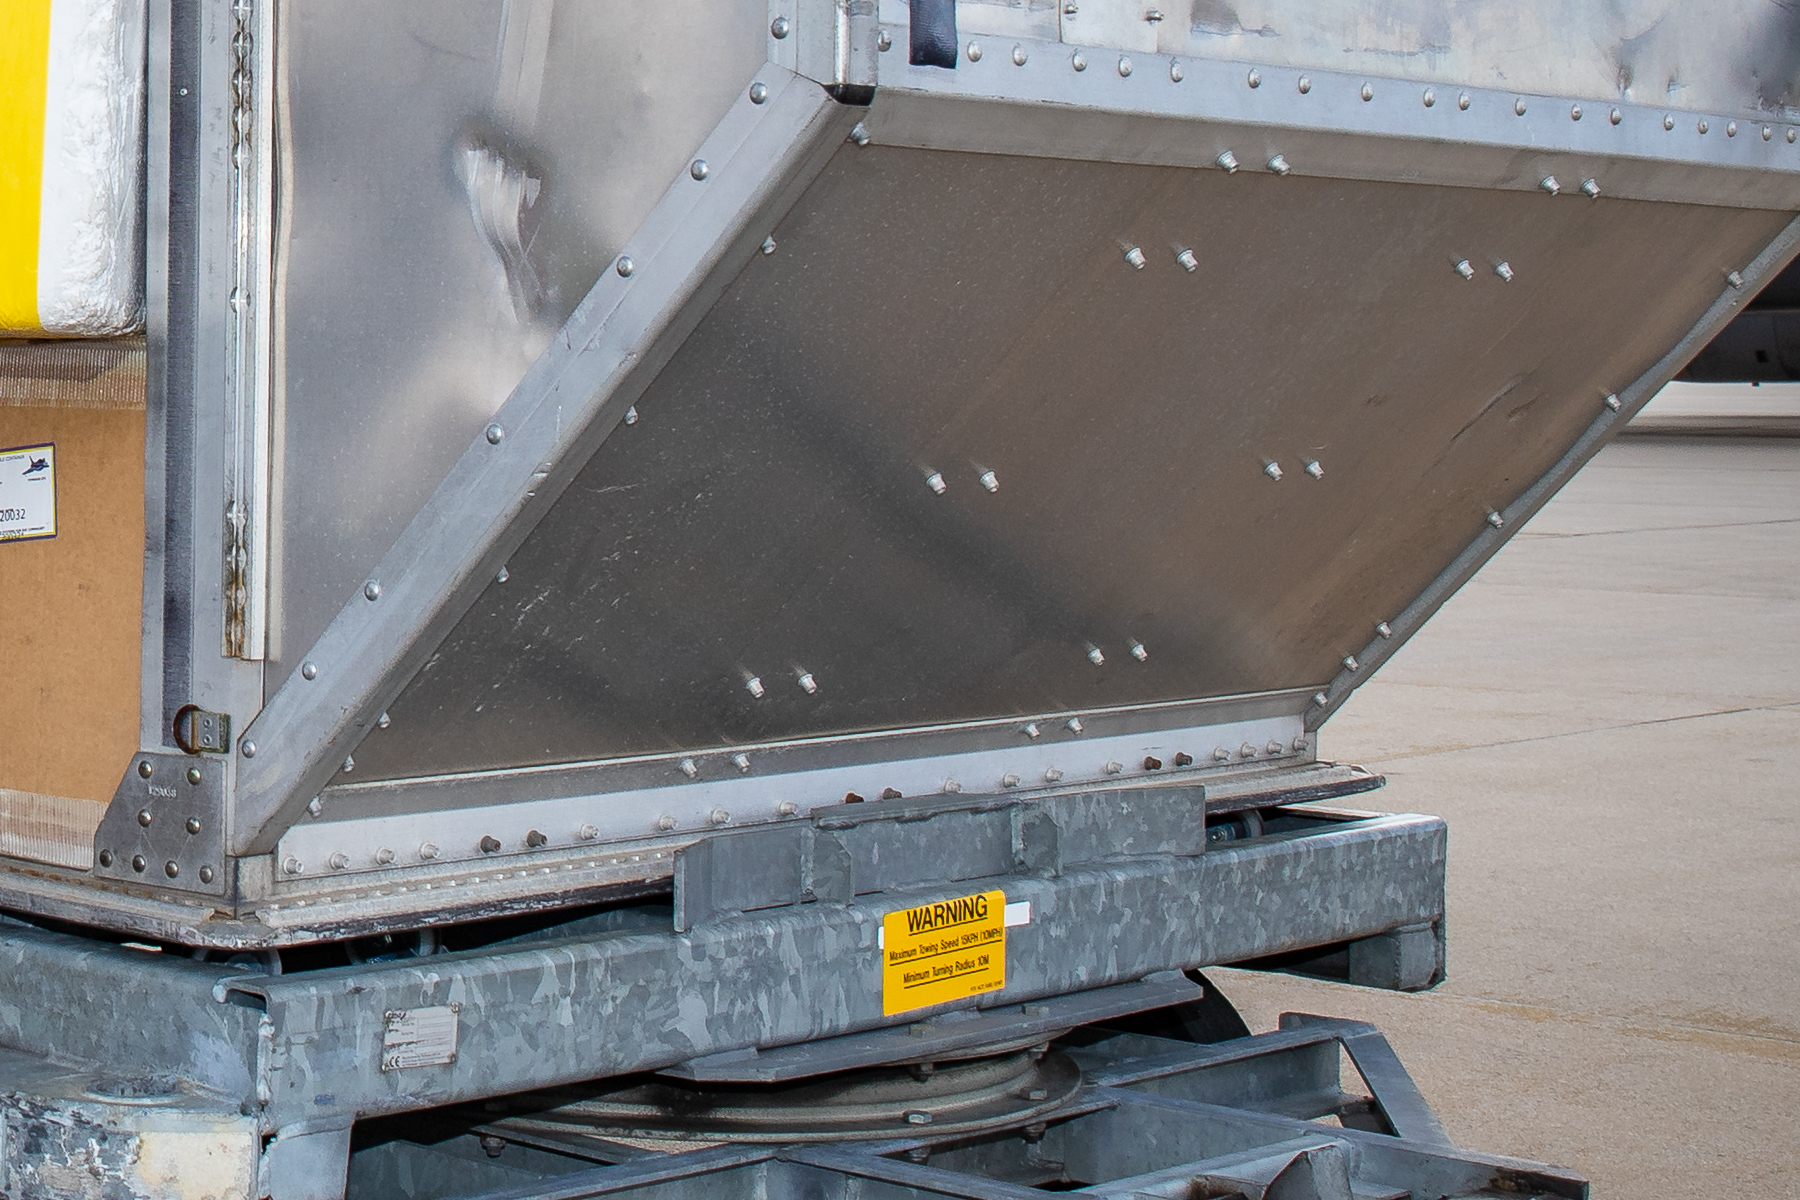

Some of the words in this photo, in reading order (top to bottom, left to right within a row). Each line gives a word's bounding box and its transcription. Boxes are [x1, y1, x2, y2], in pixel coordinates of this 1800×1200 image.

[906, 894, 988, 933] WARNING
[889, 948, 917, 961] Maximum
[919, 942, 939, 955] Towing
[940, 936, 959, 951] Speed
[903, 970, 930, 983] Minimum
[932, 963, 953, 977] Turning
[955, 958, 975, 972] Radius
